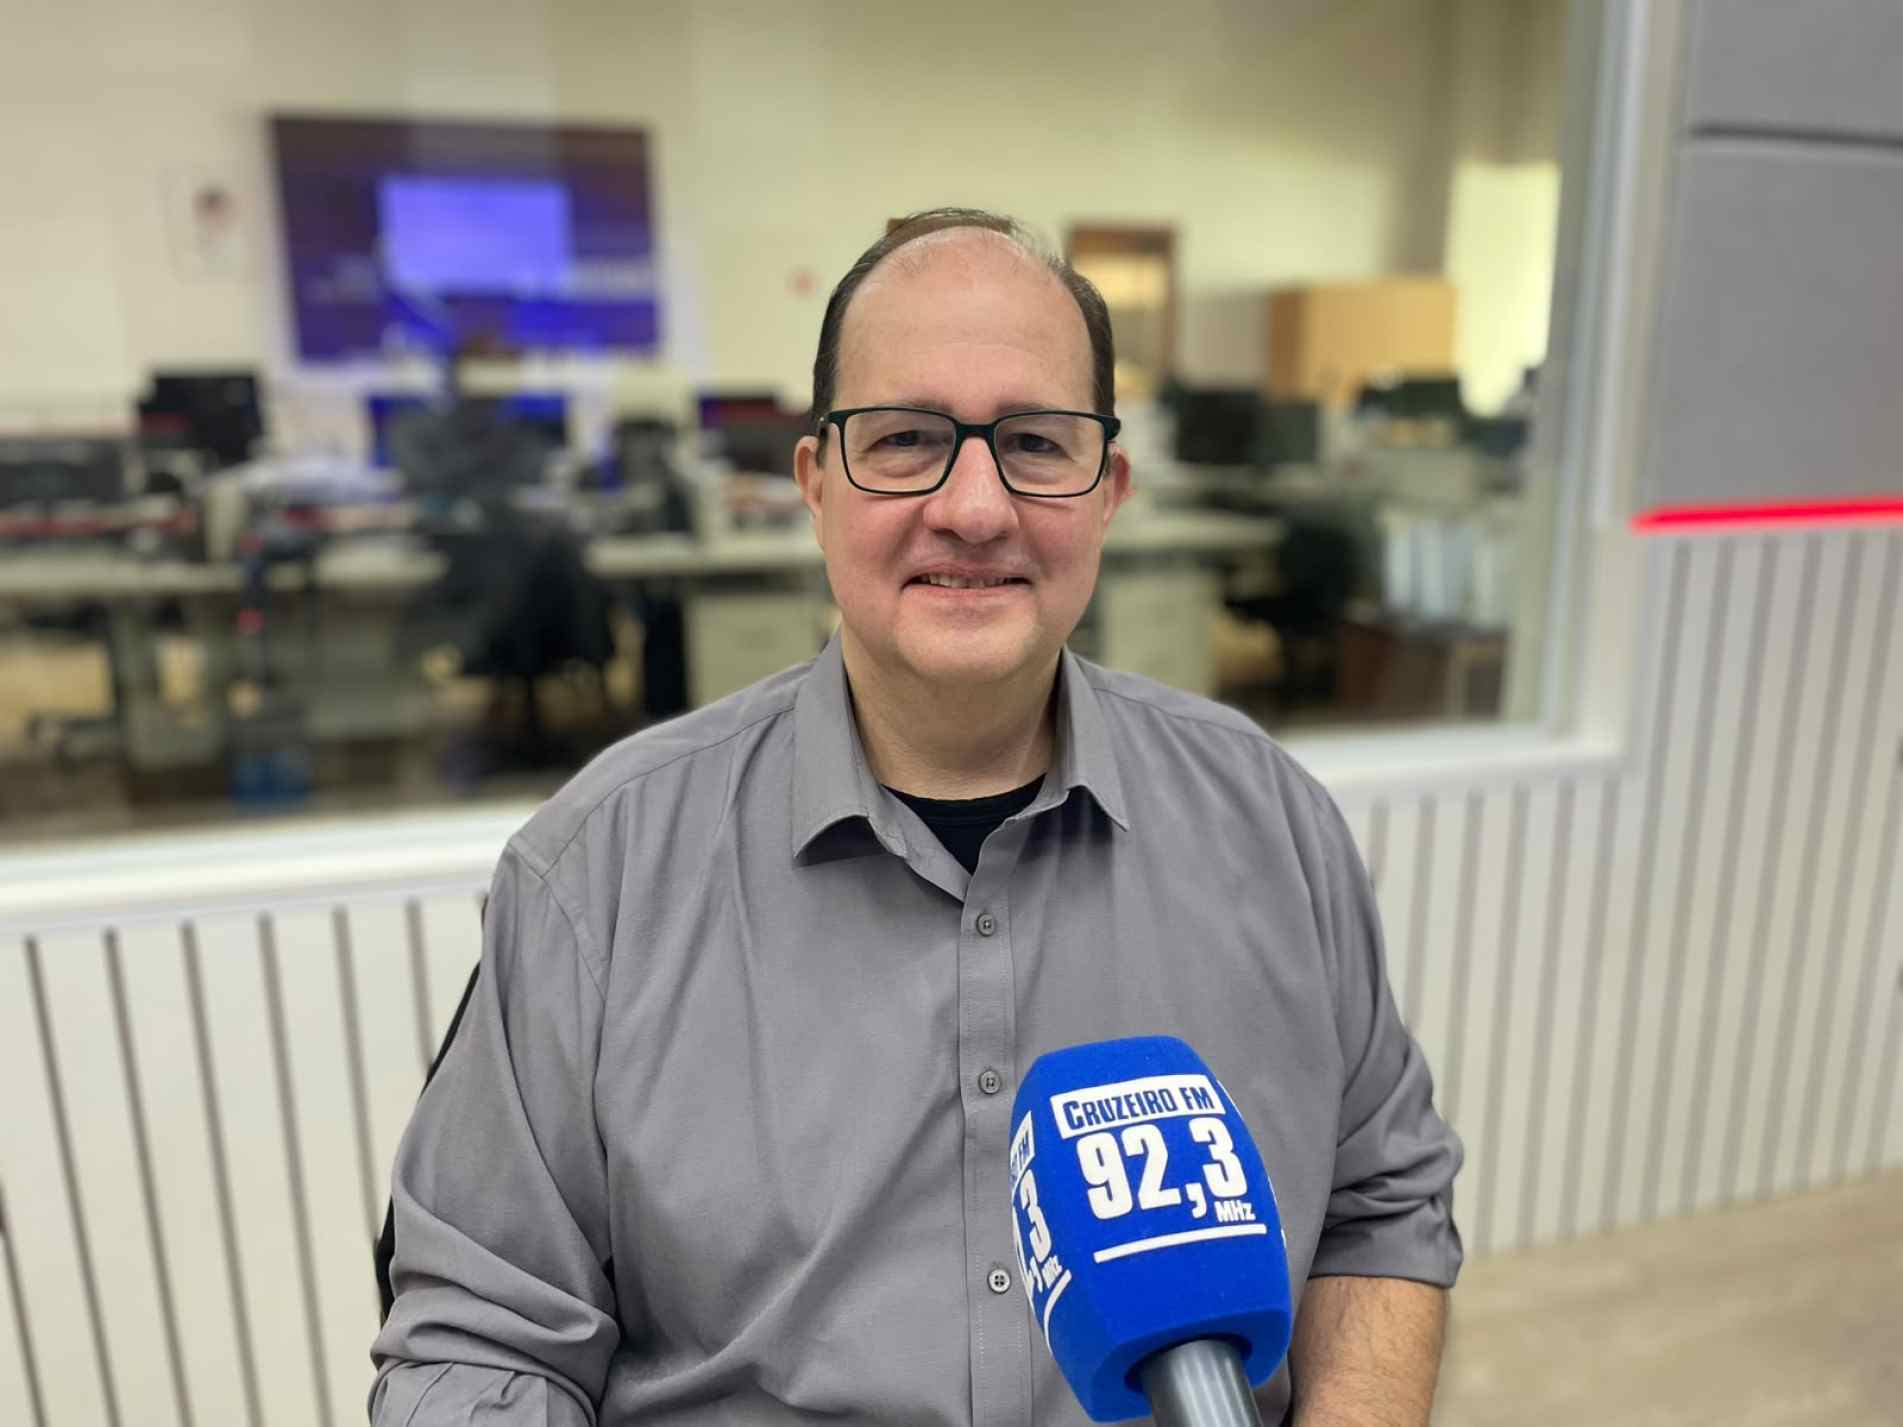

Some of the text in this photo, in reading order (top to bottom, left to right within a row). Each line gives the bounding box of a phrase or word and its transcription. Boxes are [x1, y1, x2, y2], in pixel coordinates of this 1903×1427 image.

[1063, 1087, 1214, 1130] CRUZEIRO FM
[1076, 1117, 1247, 1219] 92,3
